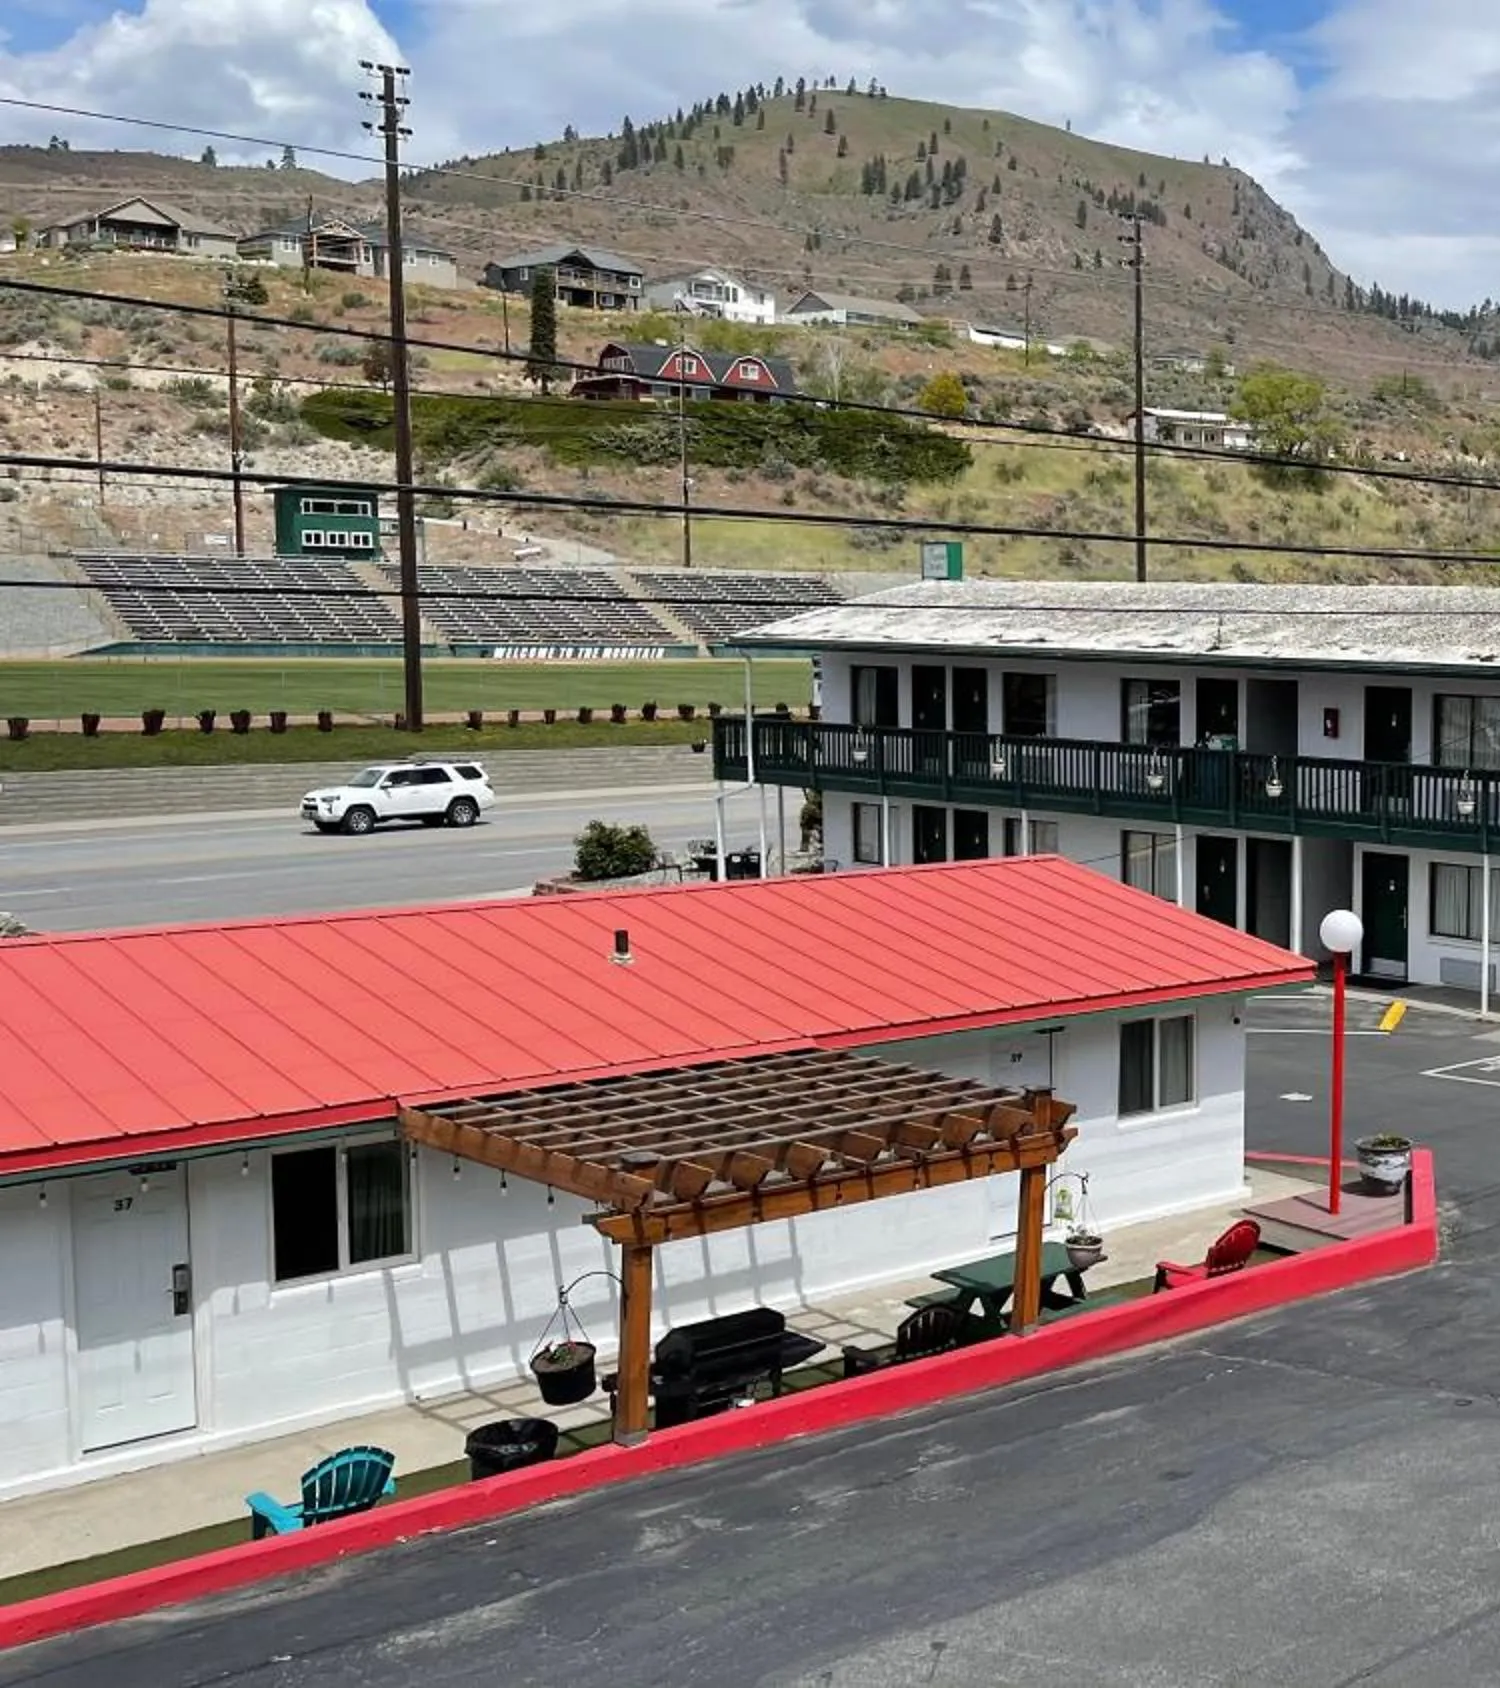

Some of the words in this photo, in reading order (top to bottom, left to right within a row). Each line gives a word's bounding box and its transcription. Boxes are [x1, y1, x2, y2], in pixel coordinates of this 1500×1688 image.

[493, 647, 555, 659] WELCOME
[559, 647, 575, 659] TO
[577, 647, 600, 659] THE
[601, 647, 666, 659] MOUNTAIN
[114, 1196, 133, 1211] 37
